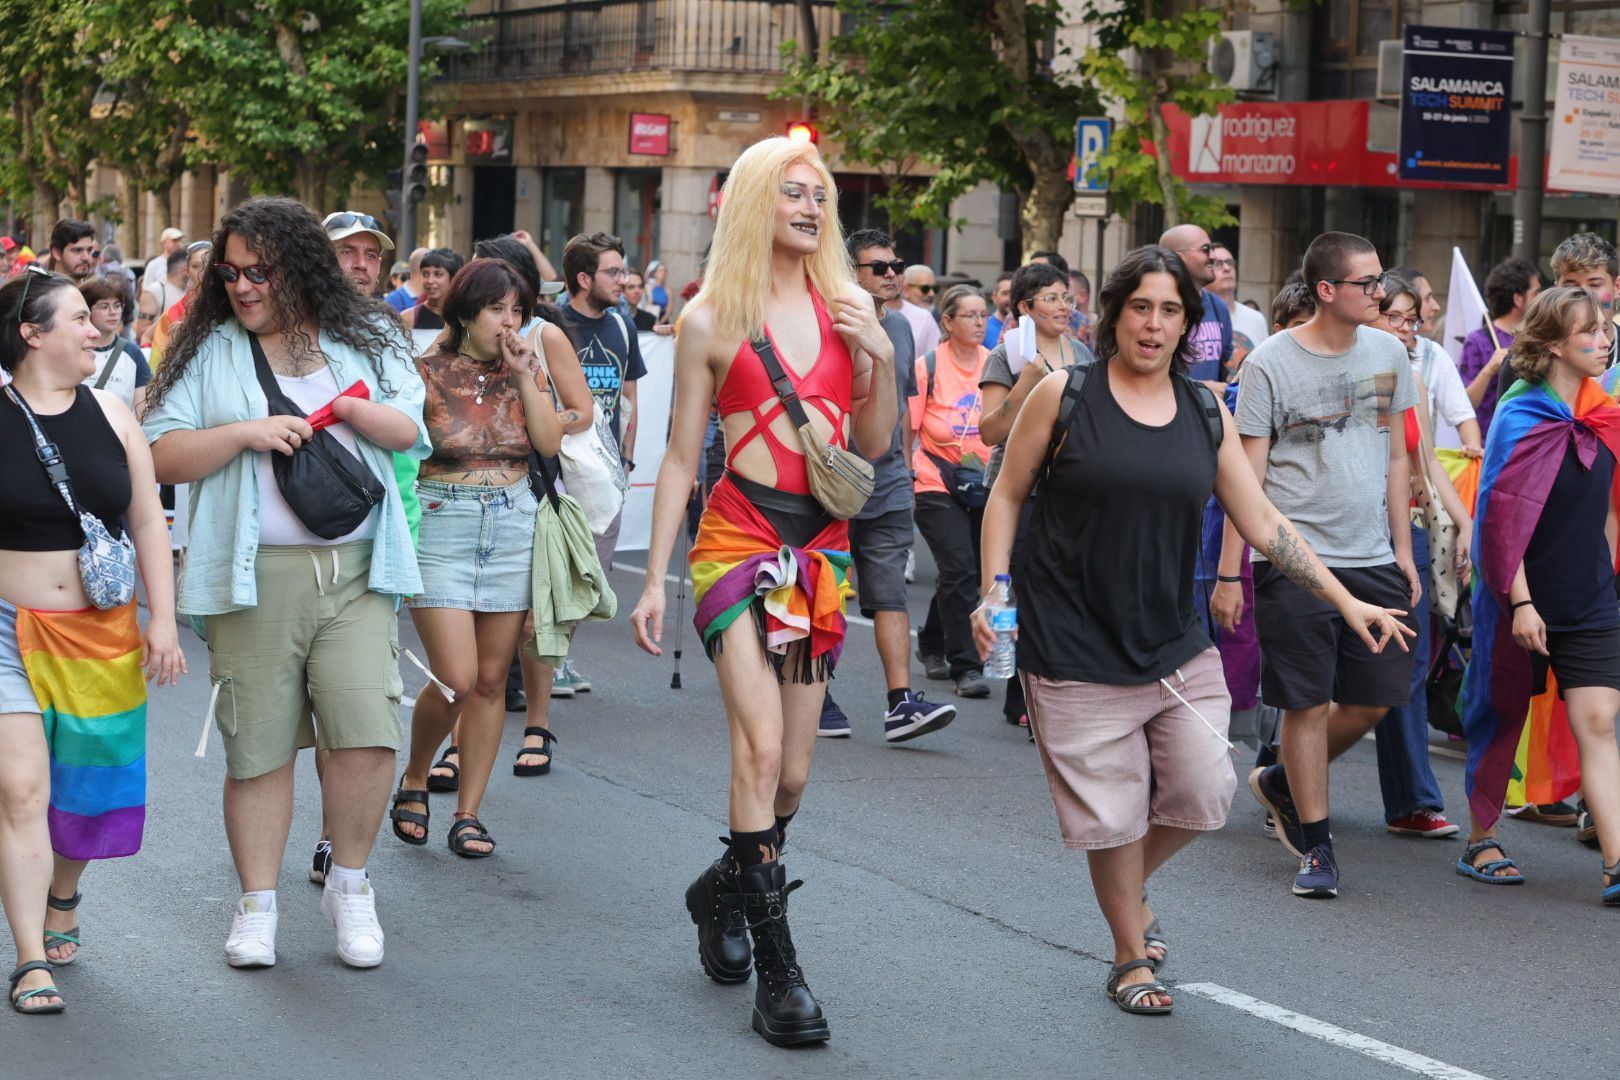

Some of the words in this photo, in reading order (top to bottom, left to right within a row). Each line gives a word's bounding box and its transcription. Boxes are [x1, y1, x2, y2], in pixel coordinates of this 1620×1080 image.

[1410, 77, 1504, 95] SALAMANCA
[1567, 87, 1605, 103] TECH
[1409, 92, 1447, 107] TECH
[1449, 95, 1504, 110] SUMMIT
[1078, 124, 1104, 188] P
[1222, 154, 1296, 175] manzano
[588, 377, 620, 388] OYD
